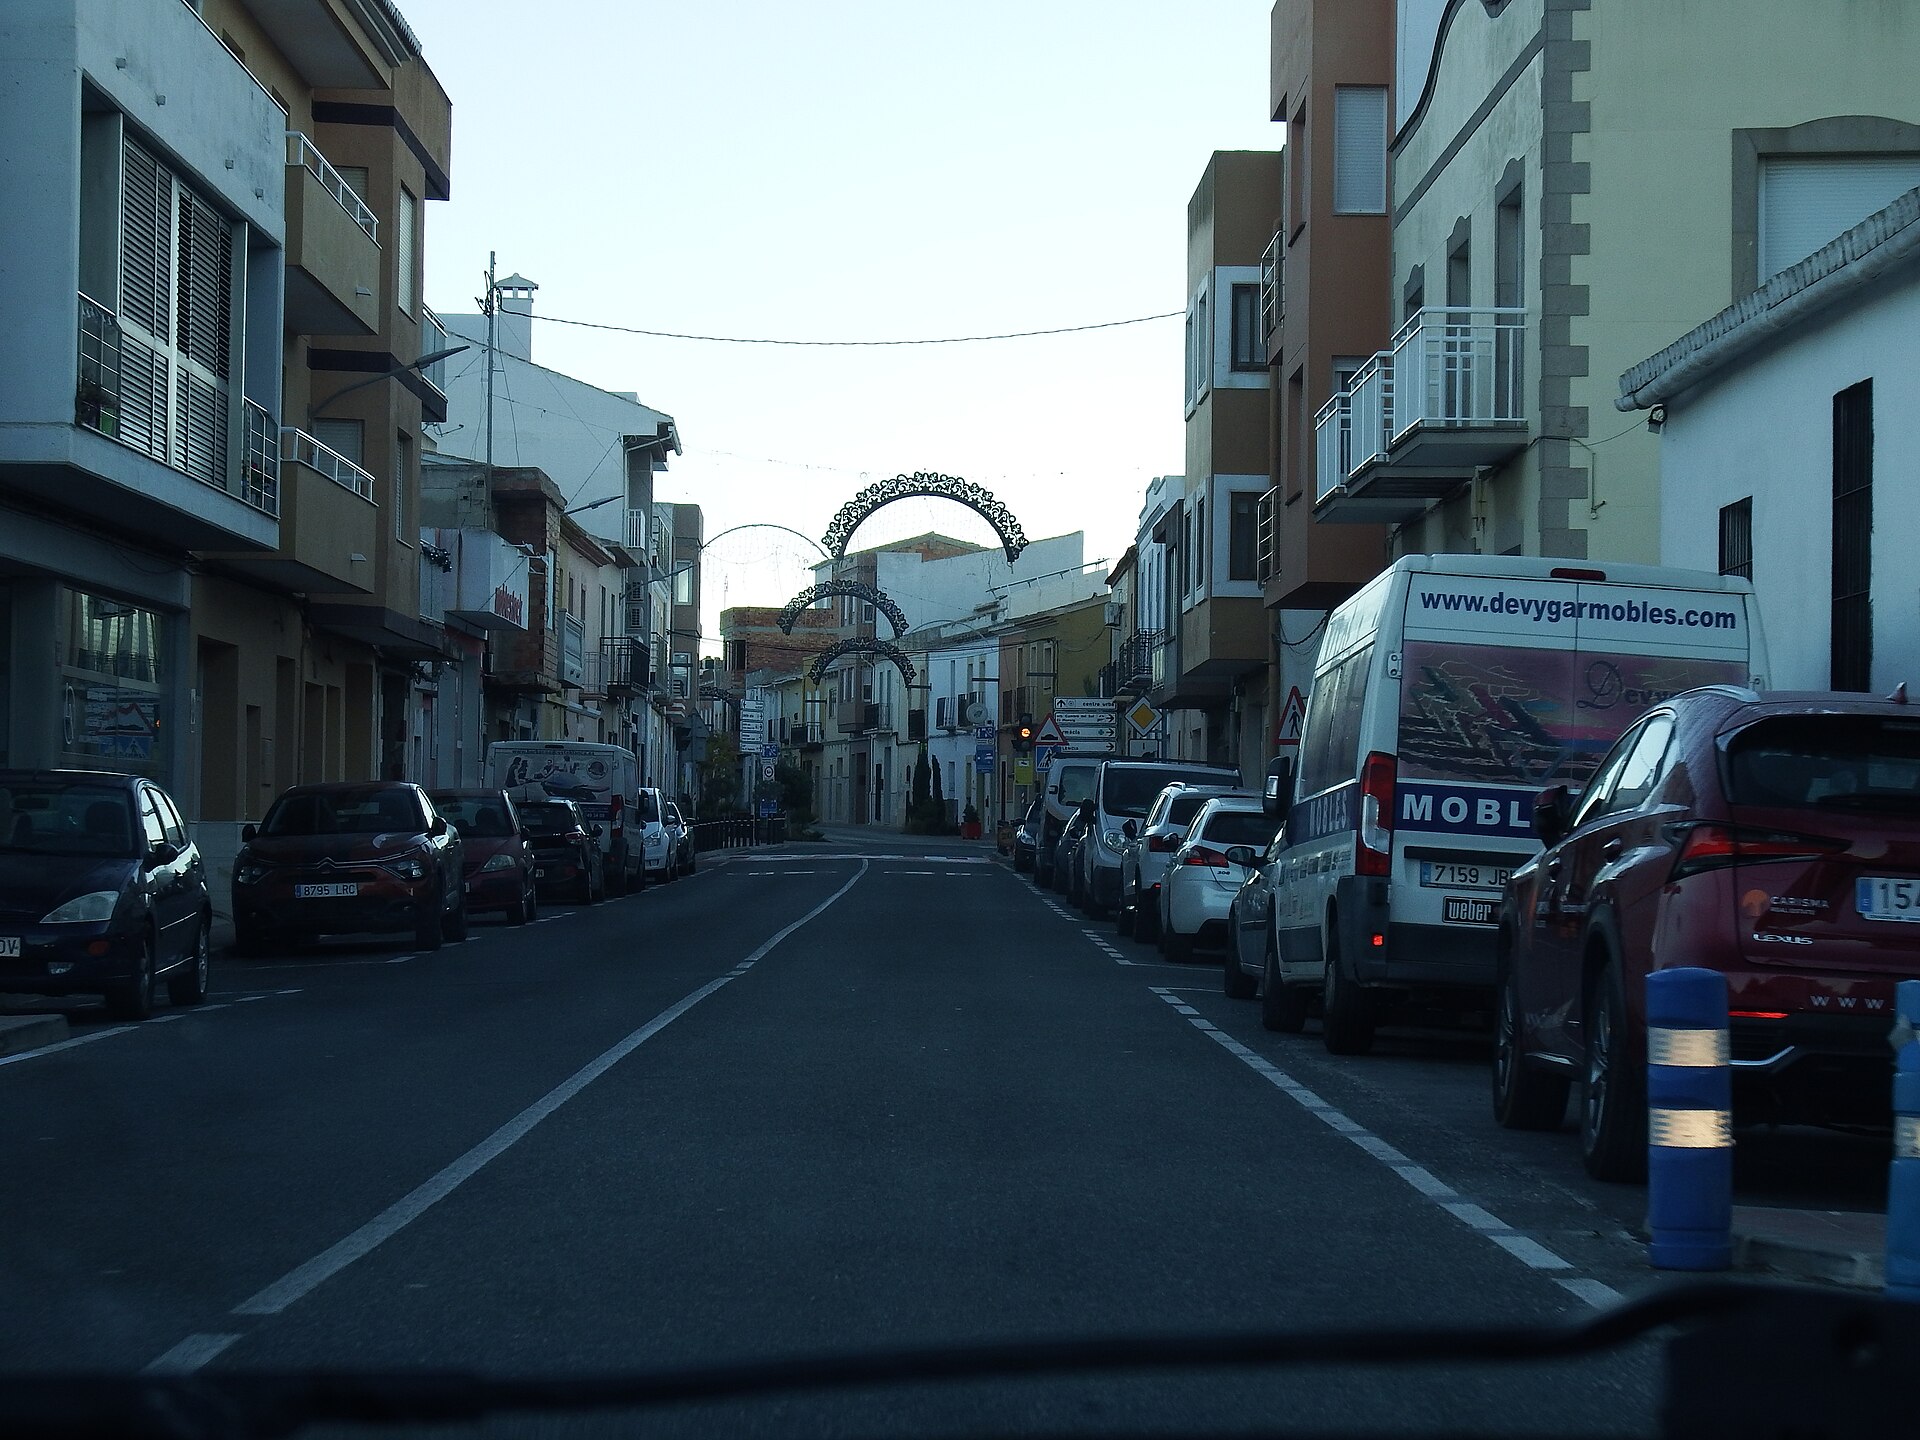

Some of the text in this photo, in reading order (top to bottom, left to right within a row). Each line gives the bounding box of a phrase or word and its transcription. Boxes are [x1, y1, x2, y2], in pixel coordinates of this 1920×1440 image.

[1421, 591, 1737, 629] www.devygarmobles.com
[1402, 793, 1531, 828] MOBL
[1435, 865, 1513, 886] 7159 JB
[304, 884, 355, 896] 8795 LRC
[1448, 900, 1492, 921] weber
[1769, 896, 1830, 909] CARISMA
[1752, 933, 1814, 945] LEXUS
